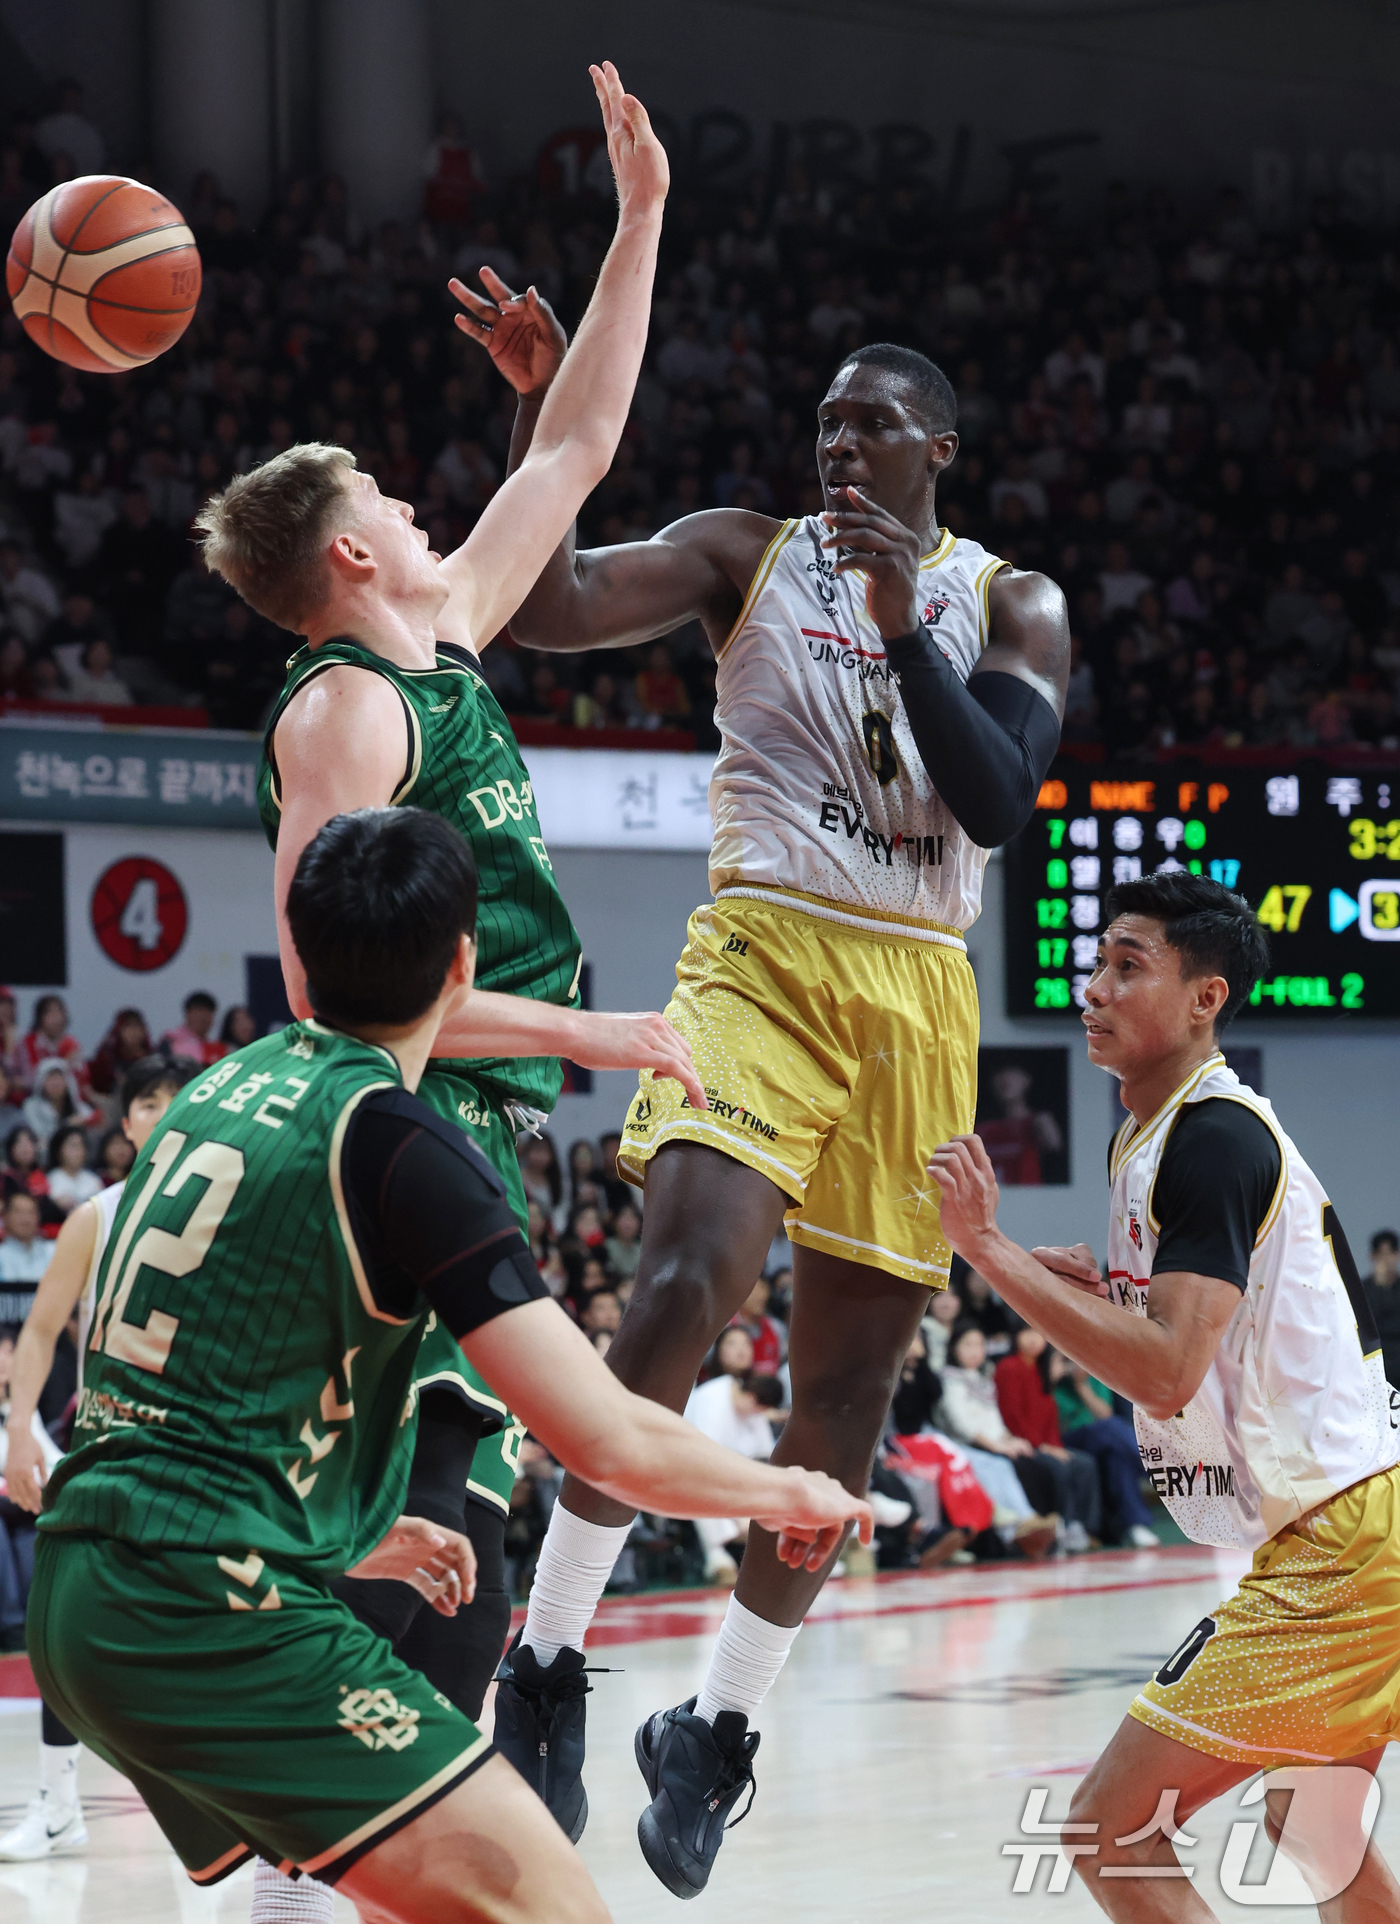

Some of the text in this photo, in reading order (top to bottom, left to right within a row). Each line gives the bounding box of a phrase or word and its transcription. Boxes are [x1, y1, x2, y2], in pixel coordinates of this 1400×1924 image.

[1178, 781, 1199, 812] F
[1207, 782, 1230, 813] P
[1046, 818, 1067, 850] 7
[119, 877, 164, 951] 4
[1257, 884, 1313, 934] 47
[1036, 937, 1070, 968] 17
[1340, 972, 1366, 1009] 2
[680, 1096, 780, 1142] EERYTIME
[89, 1127, 246, 1376] 12
